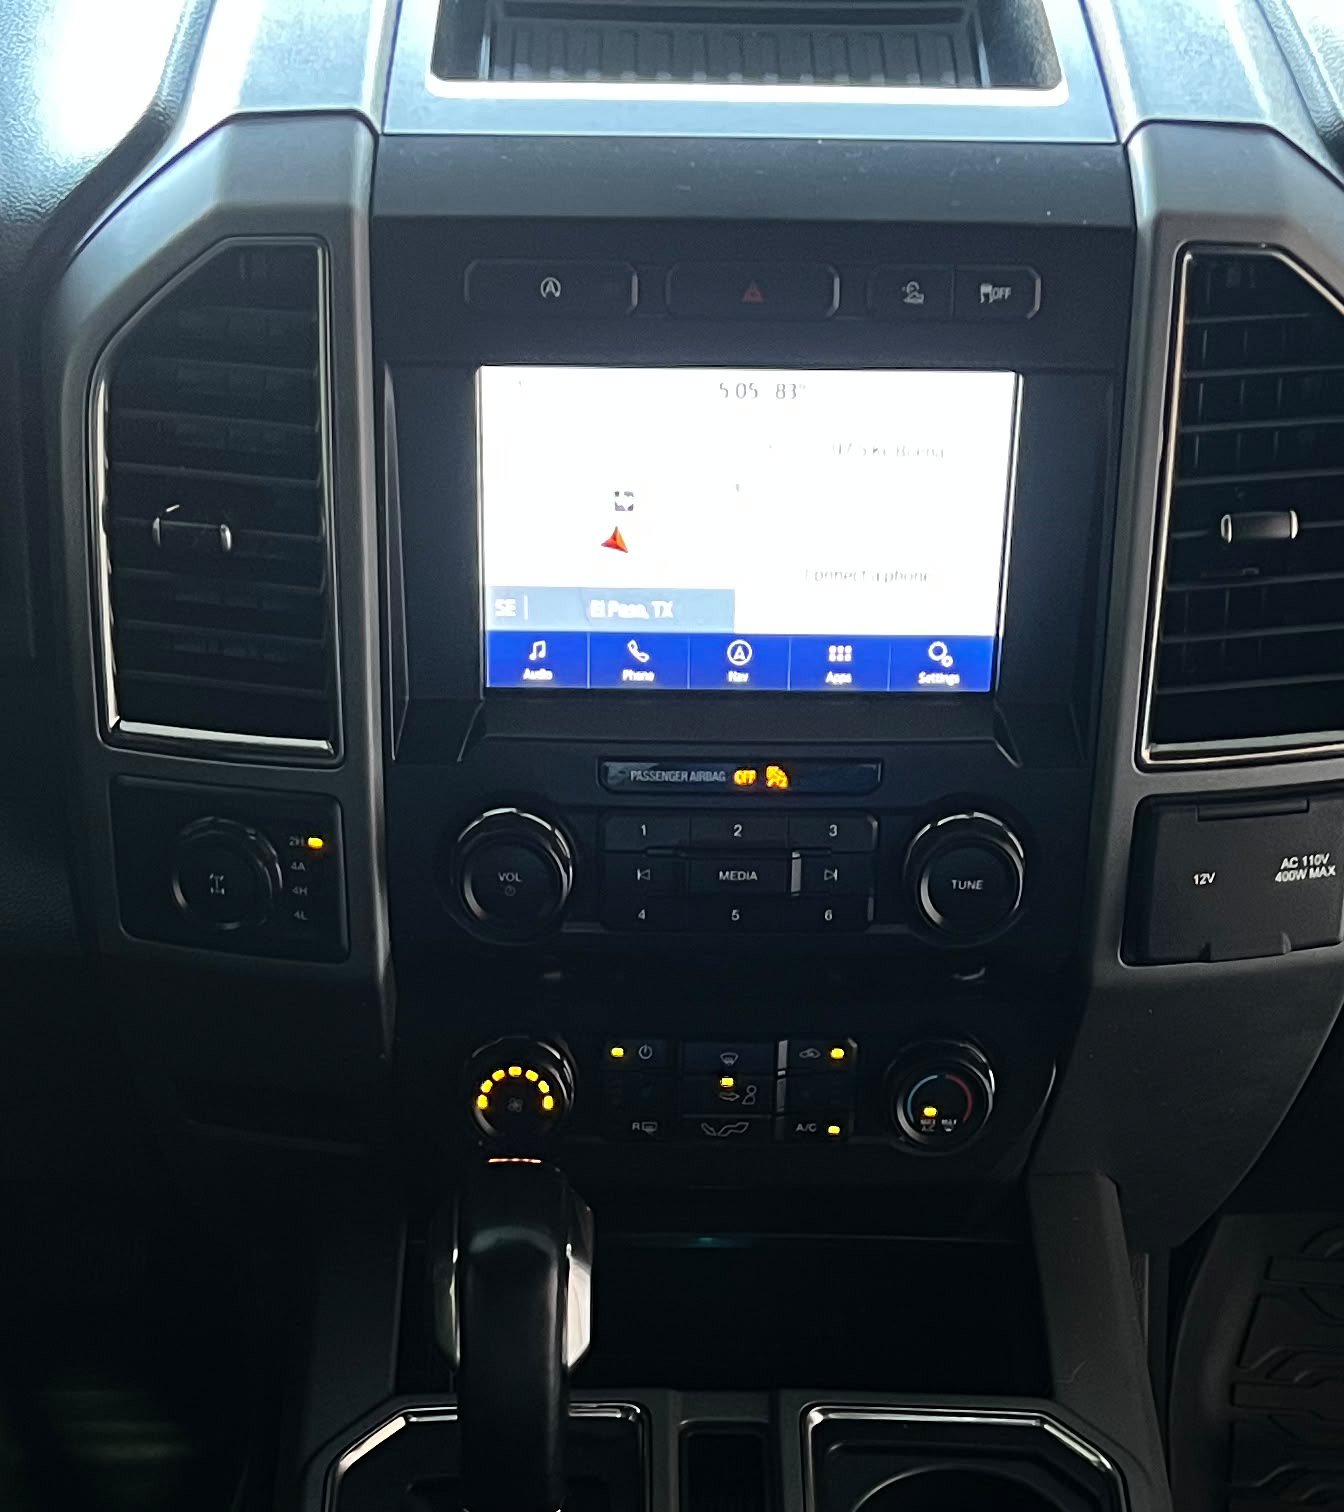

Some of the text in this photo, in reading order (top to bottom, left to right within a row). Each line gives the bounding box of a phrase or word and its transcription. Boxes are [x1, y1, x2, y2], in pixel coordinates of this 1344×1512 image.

[992, 286, 1011, 300] OFF
[494, 598, 517, 617] SE
[590, 600, 605, 618] El
[651, 600, 675, 619] TX
[523, 667, 553, 681] Audio
[622, 669, 655, 682] Phone
[727, 670, 749, 683] Nav
[825, 671, 852, 685] Apps
[918, 671, 960, 686] Settings
[630, 769, 757, 785] PASSENGER AIRBAG OFF
[640, 824, 647, 837] 1
[733, 824, 743, 837] 2
[828, 824, 838, 837] 3
[1280, 852, 1331, 870] AC 110V
[498, 872, 523, 882] VOL
[718, 870, 758, 882] MEDIA
[1193, 872, 1216, 885] 12V
[1274, 864, 1337, 883] 400W MAX
[291, 886, 308, 896] 4H
[951, 879, 984, 891] TUNE
[637, 909, 647, 921] 4
[731, 909, 740, 921] 5
[824, 909, 833, 921] 6
[795, 1122, 817, 1132] A/C
